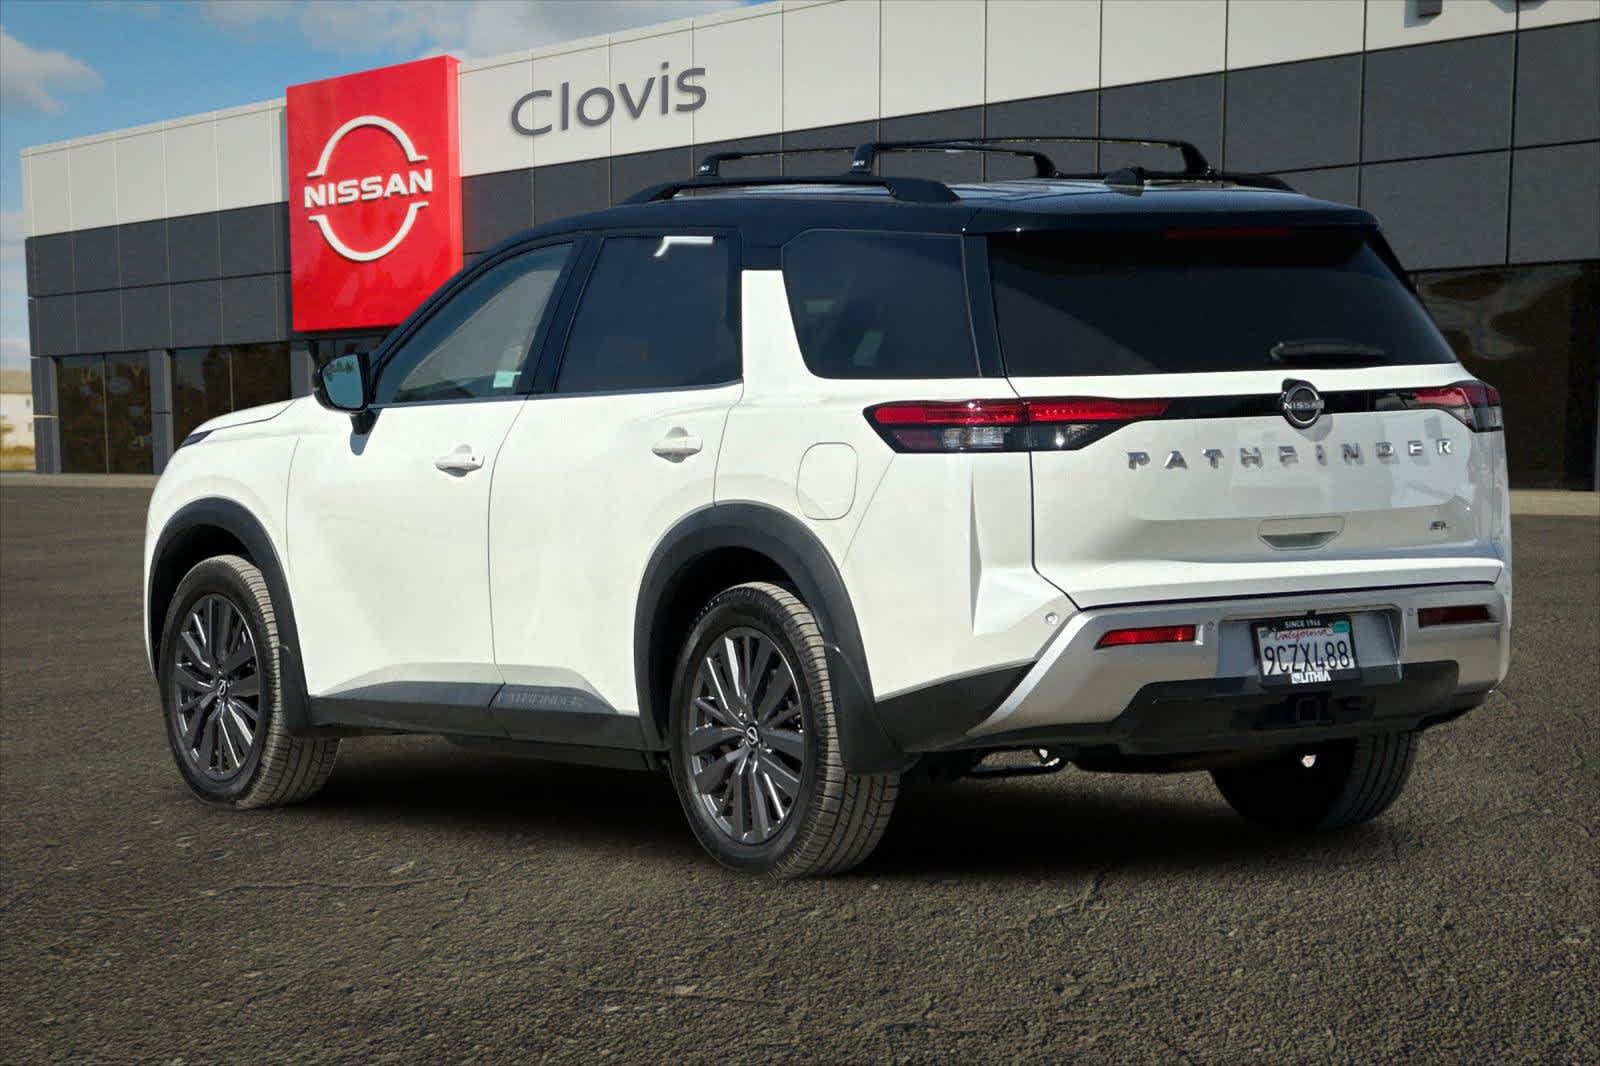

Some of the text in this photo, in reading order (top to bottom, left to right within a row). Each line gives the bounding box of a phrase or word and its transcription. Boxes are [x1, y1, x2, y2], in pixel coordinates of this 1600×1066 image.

[511, 62, 708, 137] Clovis
[304, 168, 433, 208] NISSAN
[1127, 438, 1452, 470] PATHFINDER
[1263, 640, 1350, 676] 9CZX488
